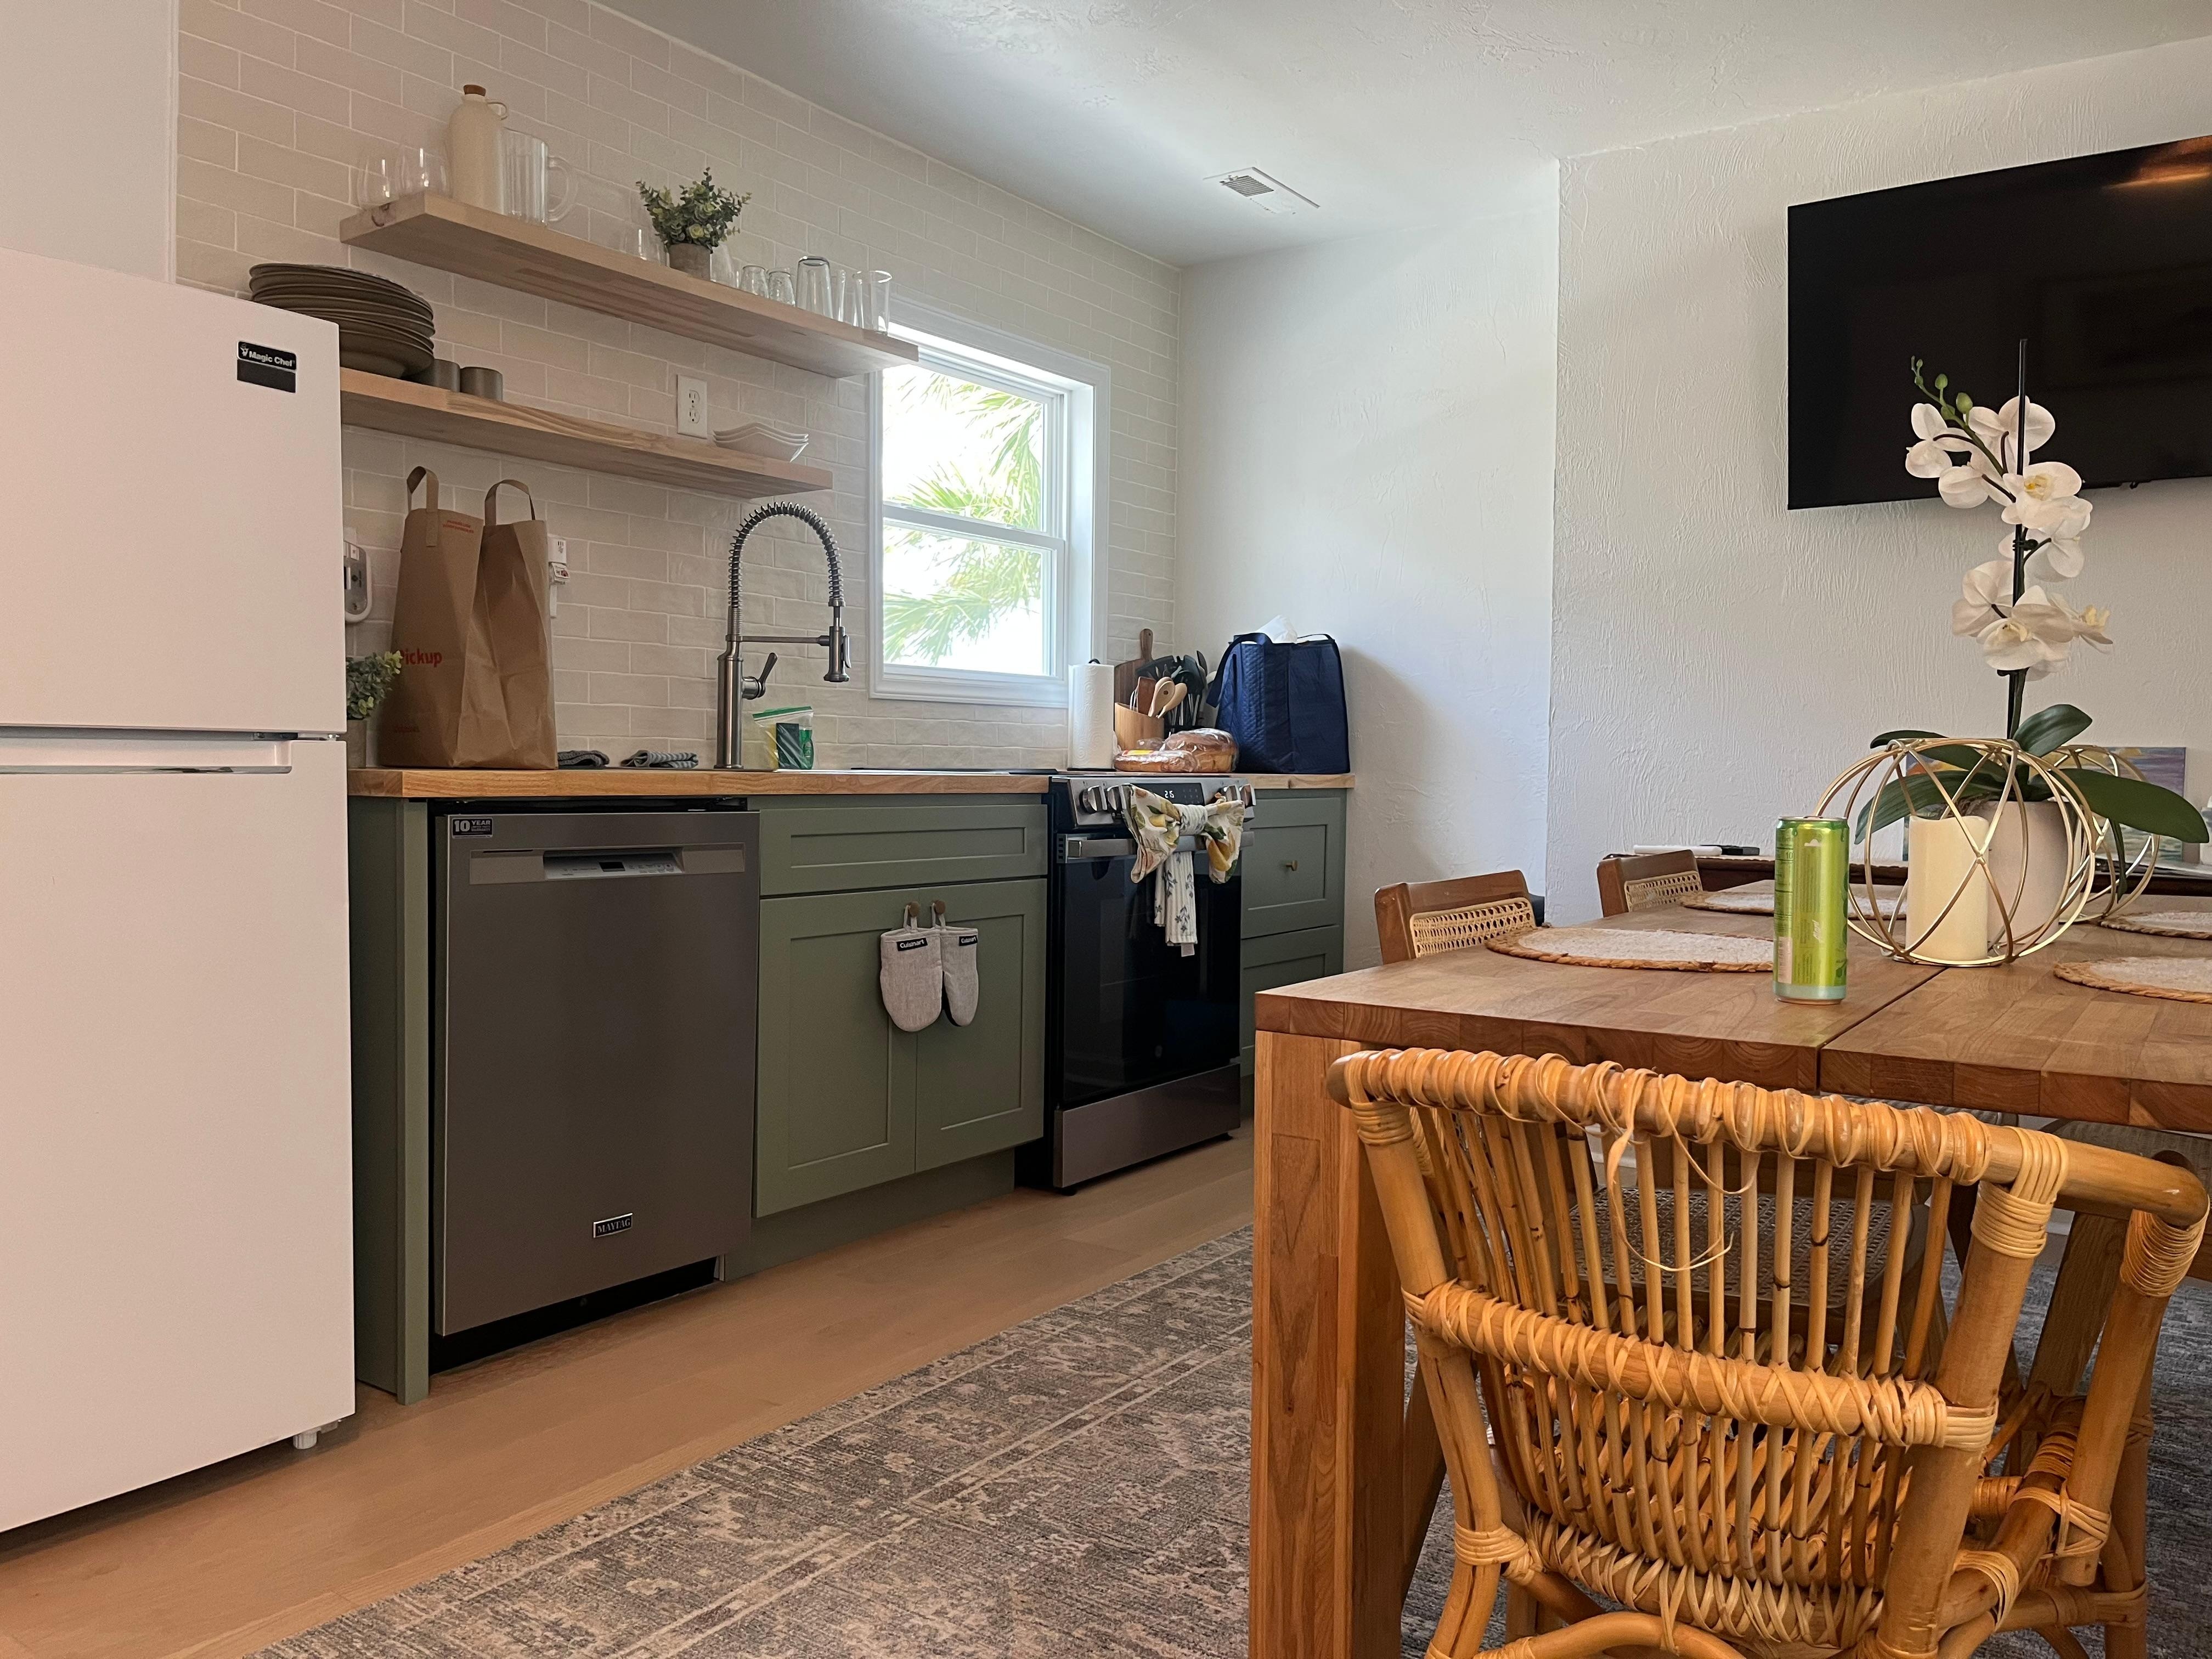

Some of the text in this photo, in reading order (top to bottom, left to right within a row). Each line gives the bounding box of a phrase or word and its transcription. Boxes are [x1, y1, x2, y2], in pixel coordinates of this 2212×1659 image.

[249, 351, 293, 366] Magic Chef
[454, 820, 470, 832] 10
[900, 939, 925, 949] Cuisinart
[597, 1218, 630, 1233] MAYTAG
